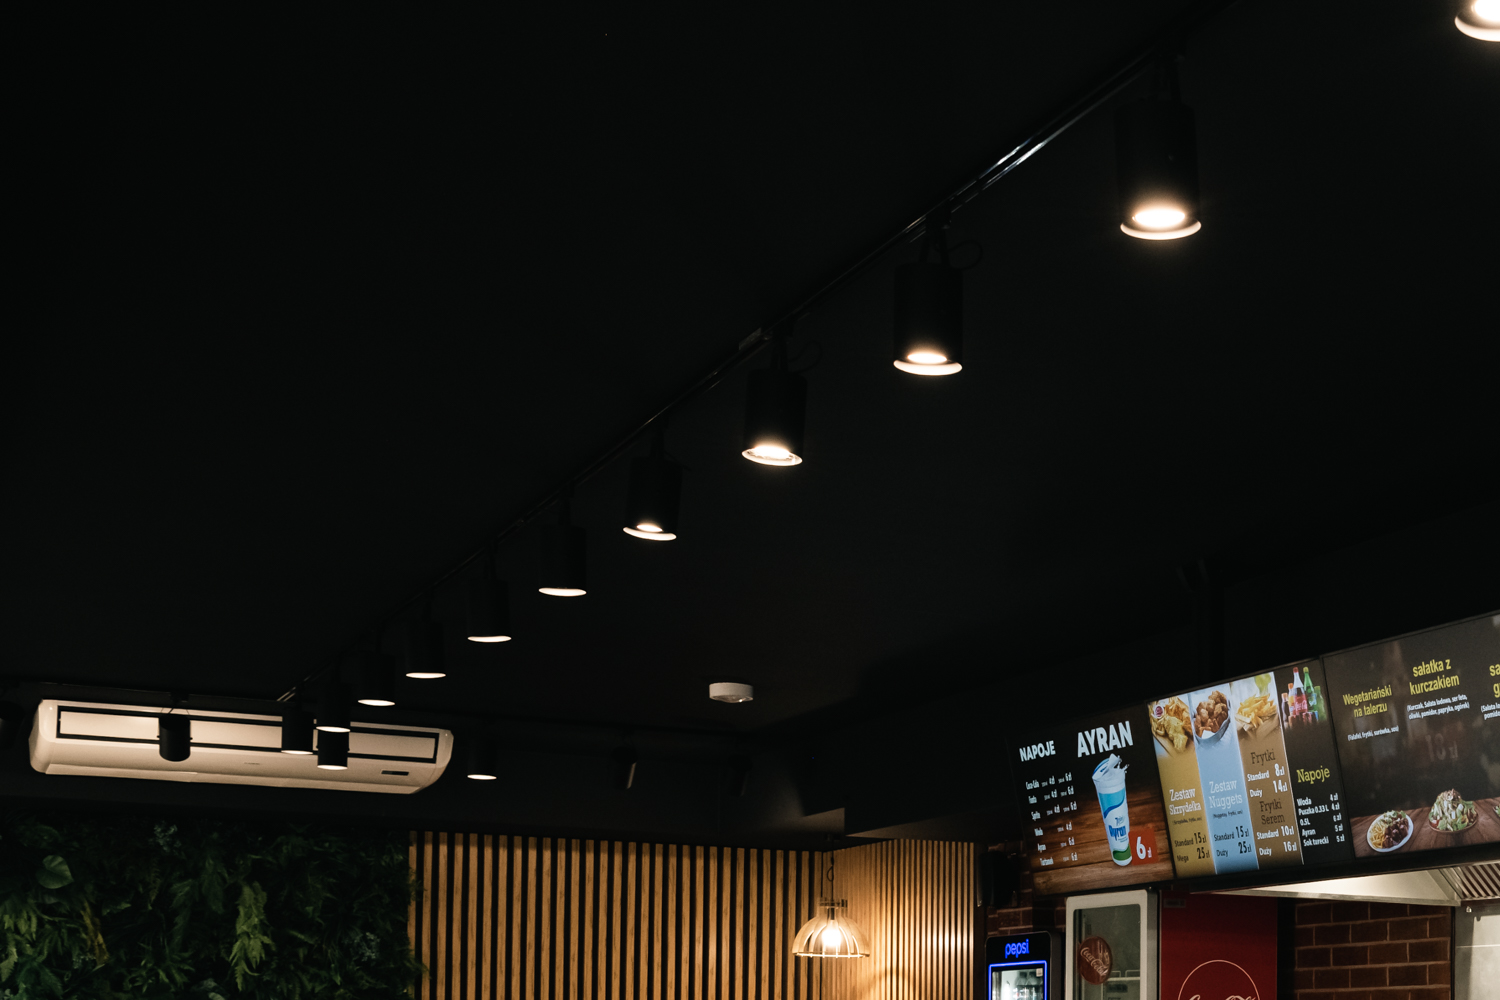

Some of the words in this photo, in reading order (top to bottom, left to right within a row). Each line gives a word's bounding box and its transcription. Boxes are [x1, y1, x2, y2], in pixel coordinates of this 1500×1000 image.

[1413, 659, 1444, 677] sałatka
[1445, 659, 1451, 670] z
[1409, 675, 1459, 695] kurczakiem
[1343, 685, 1392, 706] Wegetariański
[1354, 708, 1362, 717] na
[1364, 703, 1387, 716] talerzu
[1019, 740, 1056, 762] NAPOJE
[1078, 721, 1133, 757] AYRAN
[1251, 749, 1276, 765] Frytki
[1247, 770, 1269, 781] Standard
[1296, 765, 1330, 784] Napoje
[1169, 788, 1195, 801] Zestaw
[1209, 781, 1237, 793] Zestaw
[1209, 794, 1242, 809] Nuggets
[1260, 798, 1282, 813] Frytki
[1261, 814, 1285, 825] Serem
[1214, 832, 1234, 841] Standard
[1257, 829, 1279, 840] Standard
[1136, 836, 1146, 859] 6
[1175, 838, 1194, 847] Standard
[1005, 939, 1030, 958] pepsi
